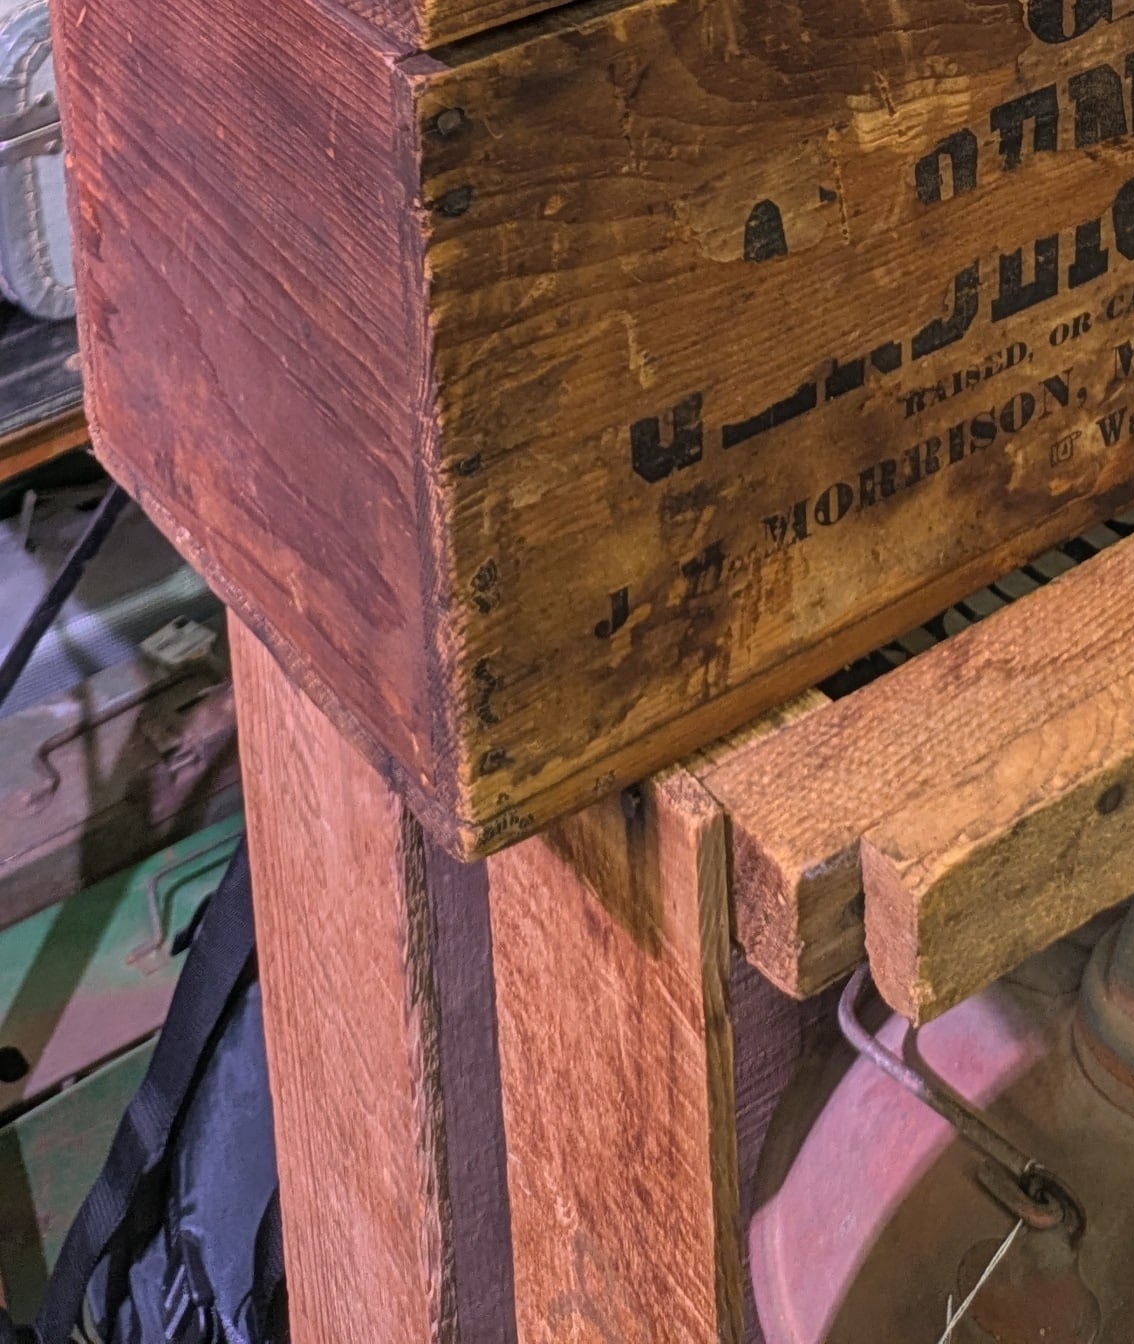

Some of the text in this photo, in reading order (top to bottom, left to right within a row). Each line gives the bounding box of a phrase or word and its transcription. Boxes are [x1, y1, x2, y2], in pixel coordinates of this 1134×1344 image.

[899, 340, 1034, 419] RAISED,
[1049, 312, 1093, 347] OR
[762, 368, 1089, 548] MORRISON,
